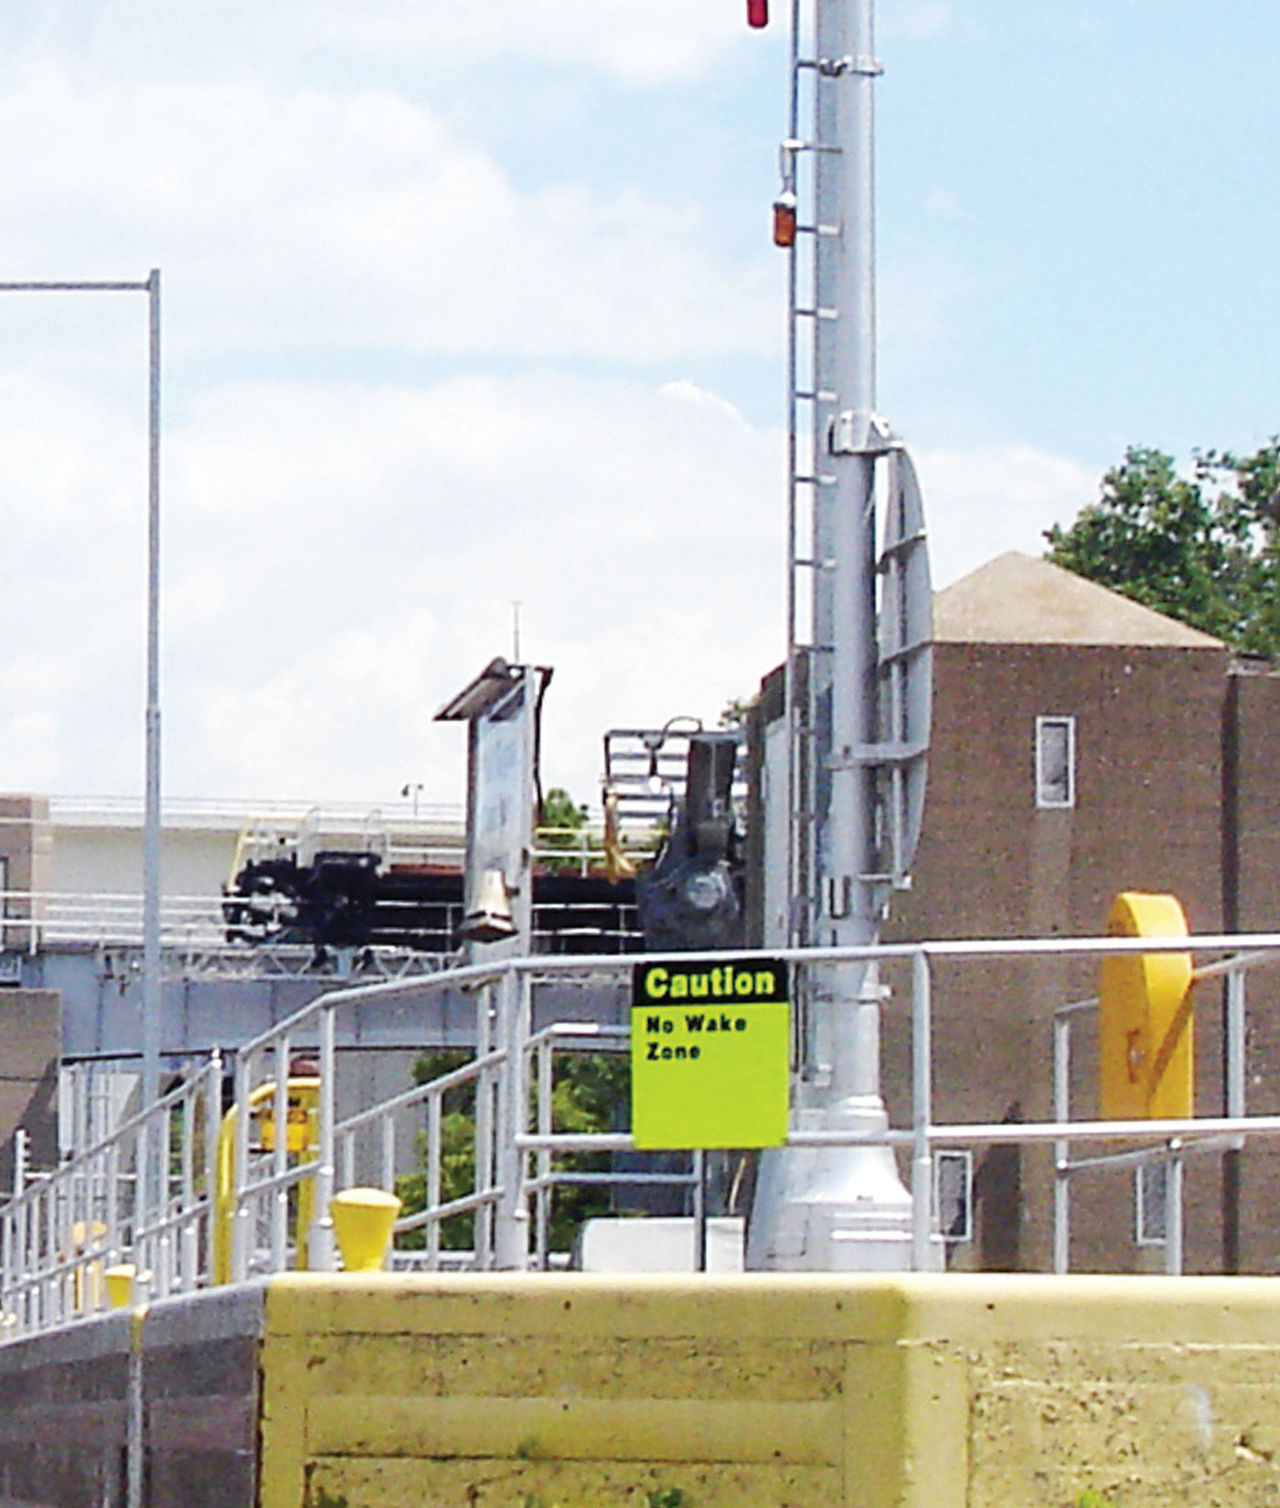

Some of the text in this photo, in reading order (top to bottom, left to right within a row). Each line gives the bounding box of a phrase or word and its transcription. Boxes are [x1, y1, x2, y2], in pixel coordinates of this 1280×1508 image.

[645, 966, 775, 998] Caution
[646, 1013, 747, 1034] No Wake
[646, 1042, 701, 1060] Zone
